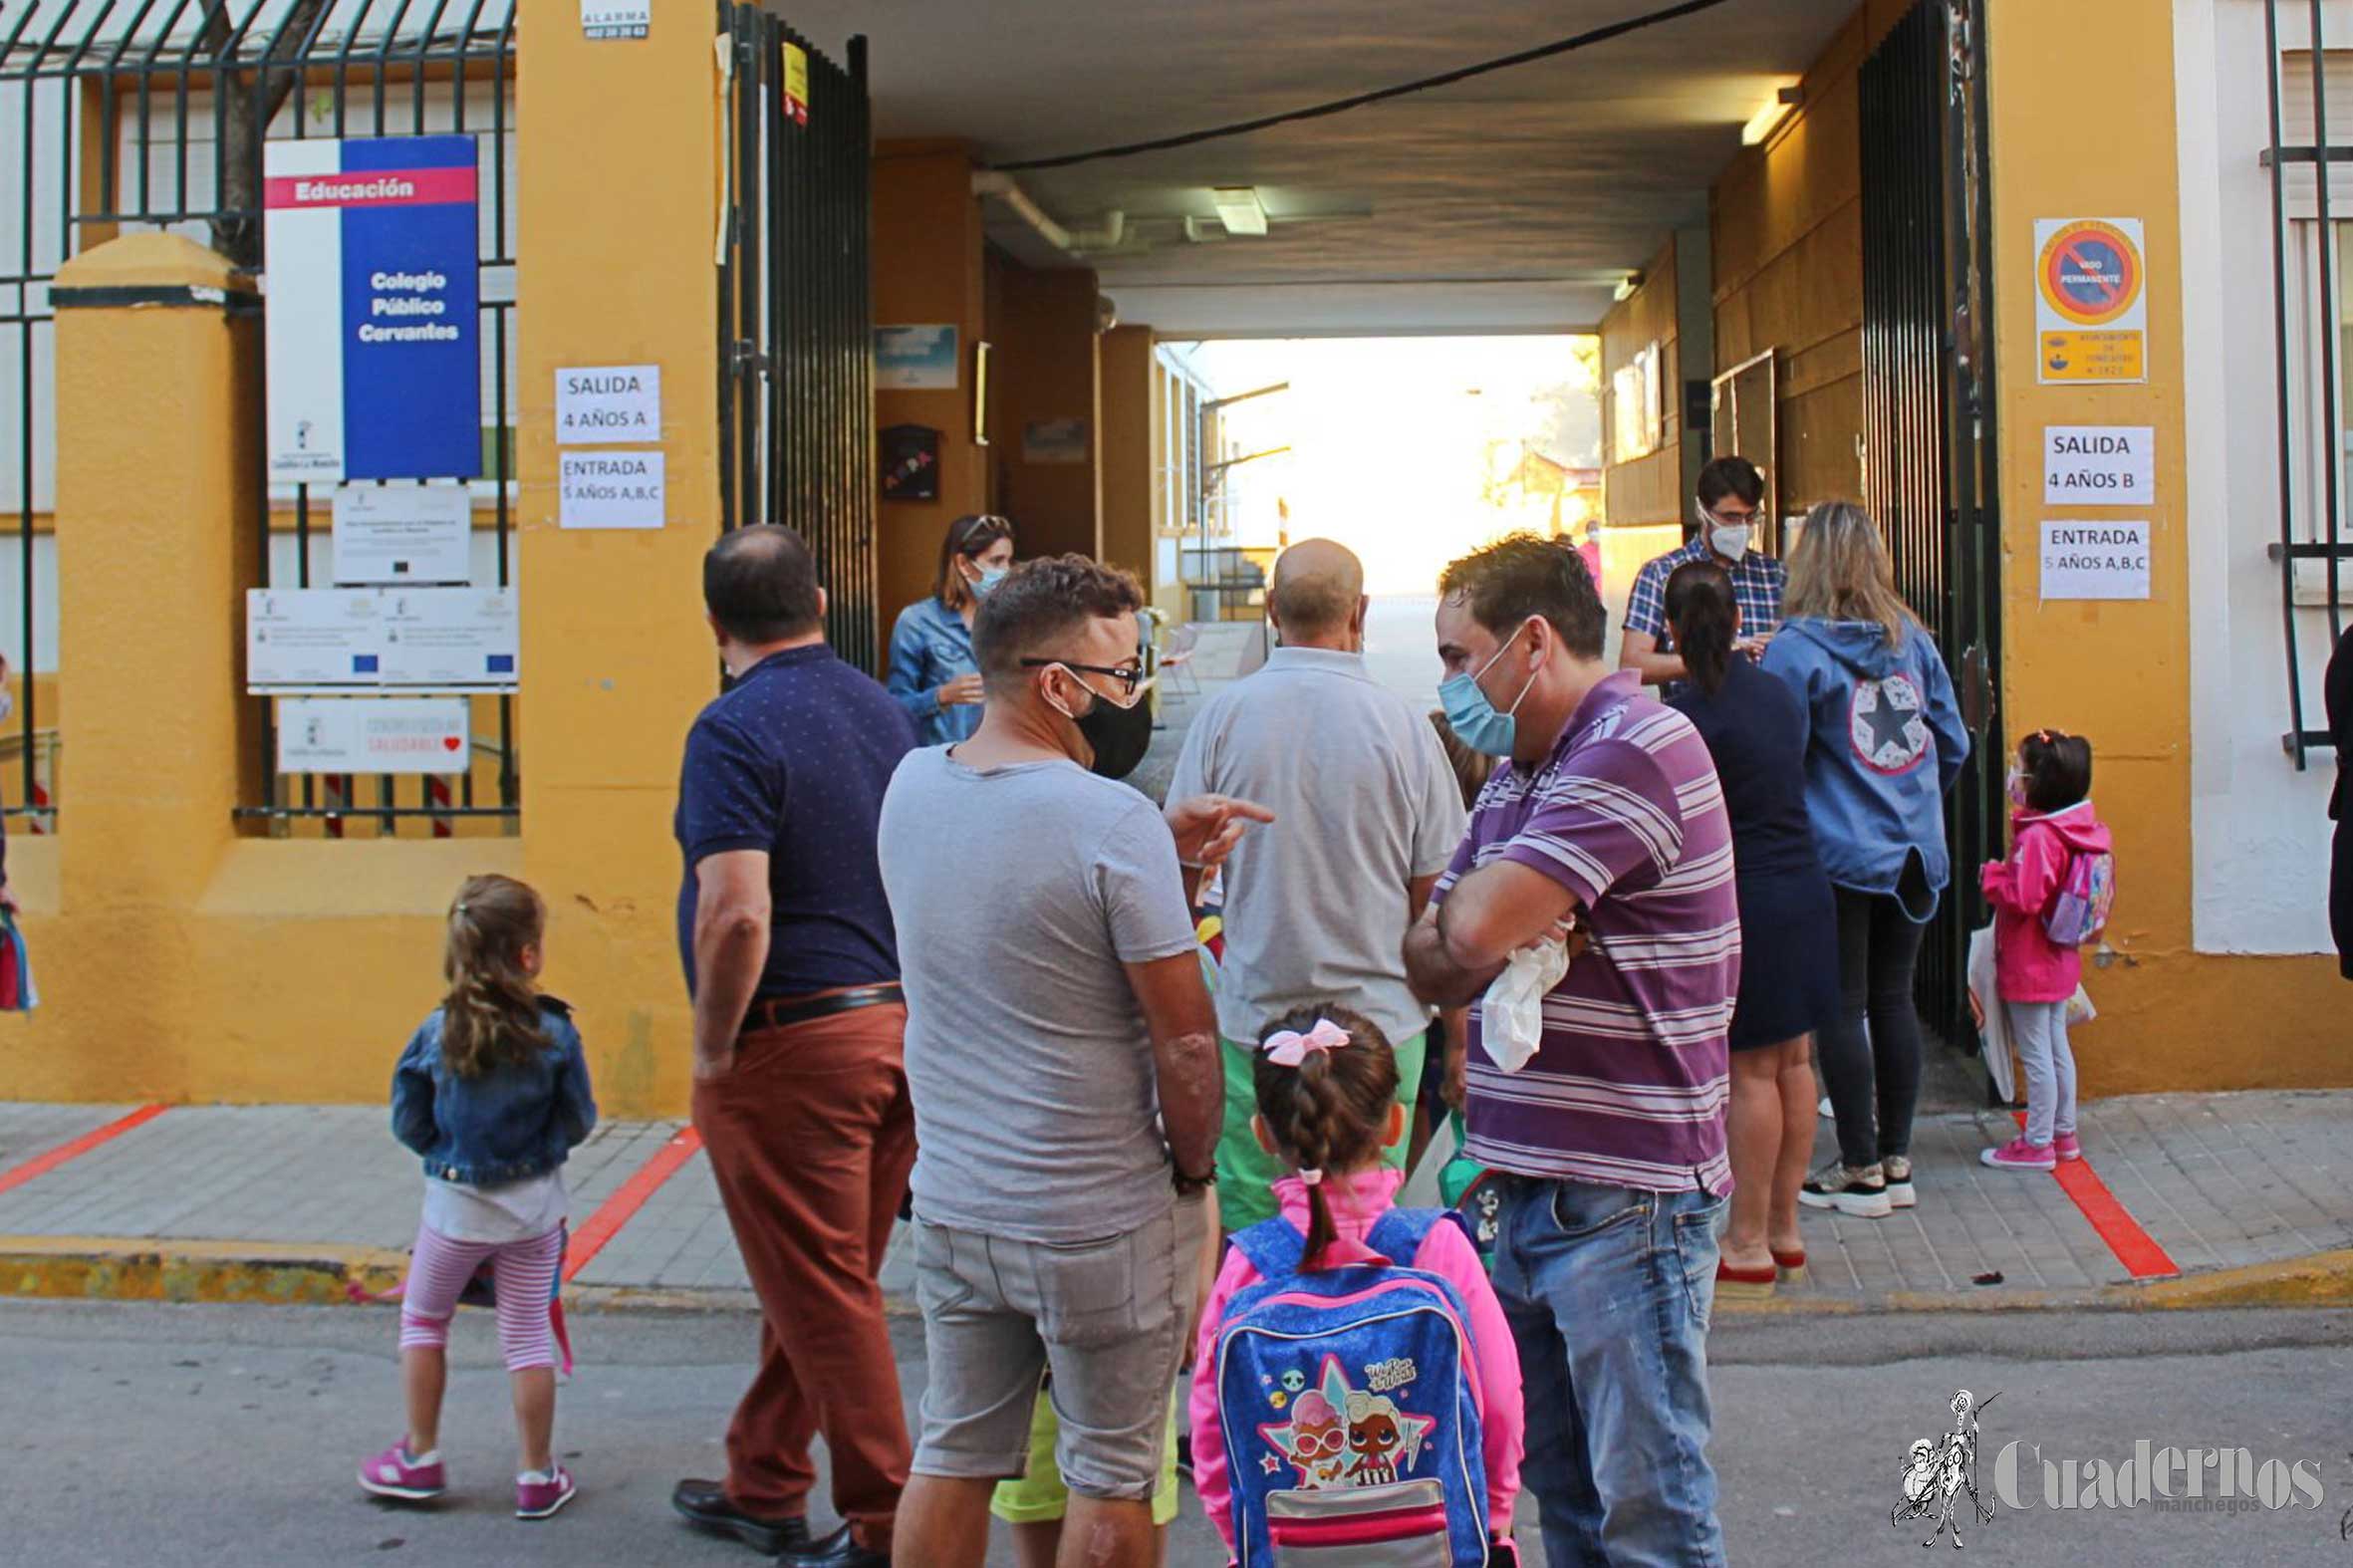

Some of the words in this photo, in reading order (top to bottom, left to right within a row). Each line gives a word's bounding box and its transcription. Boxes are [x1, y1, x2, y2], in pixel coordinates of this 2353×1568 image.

[584, 11, 648, 22] ALARMA
[295, 178, 413, 200] Educación
[371, 272, 446, 292] Colegio
[373, 297, 445, 316] Público
[359, 322, 458, 342] Cervantes
[567, 375, 642, 395] SALIDA
[564, 413, 575, 427] 4
[579, 408, 629, 427] AÑOS
[634, 411, 647, 426] A
[2053, 436, 2130, 454] SALIDA
[564, 460, 647, 476] ENTRADA
[2048, 473, 2059, 488] 4
[2065, 469, 2117, 488] AÑOS
[2123, 473, 2134, 488] B
[576, 483, 618, 499] AÑOS
[621, 486, 659, 501] A,B,C
[2051, 530, 2139, 545] ENTRADA
[2058, 553, 2101, 570] AÑOS
[2105, 557, 2145, 571] A,B,C
